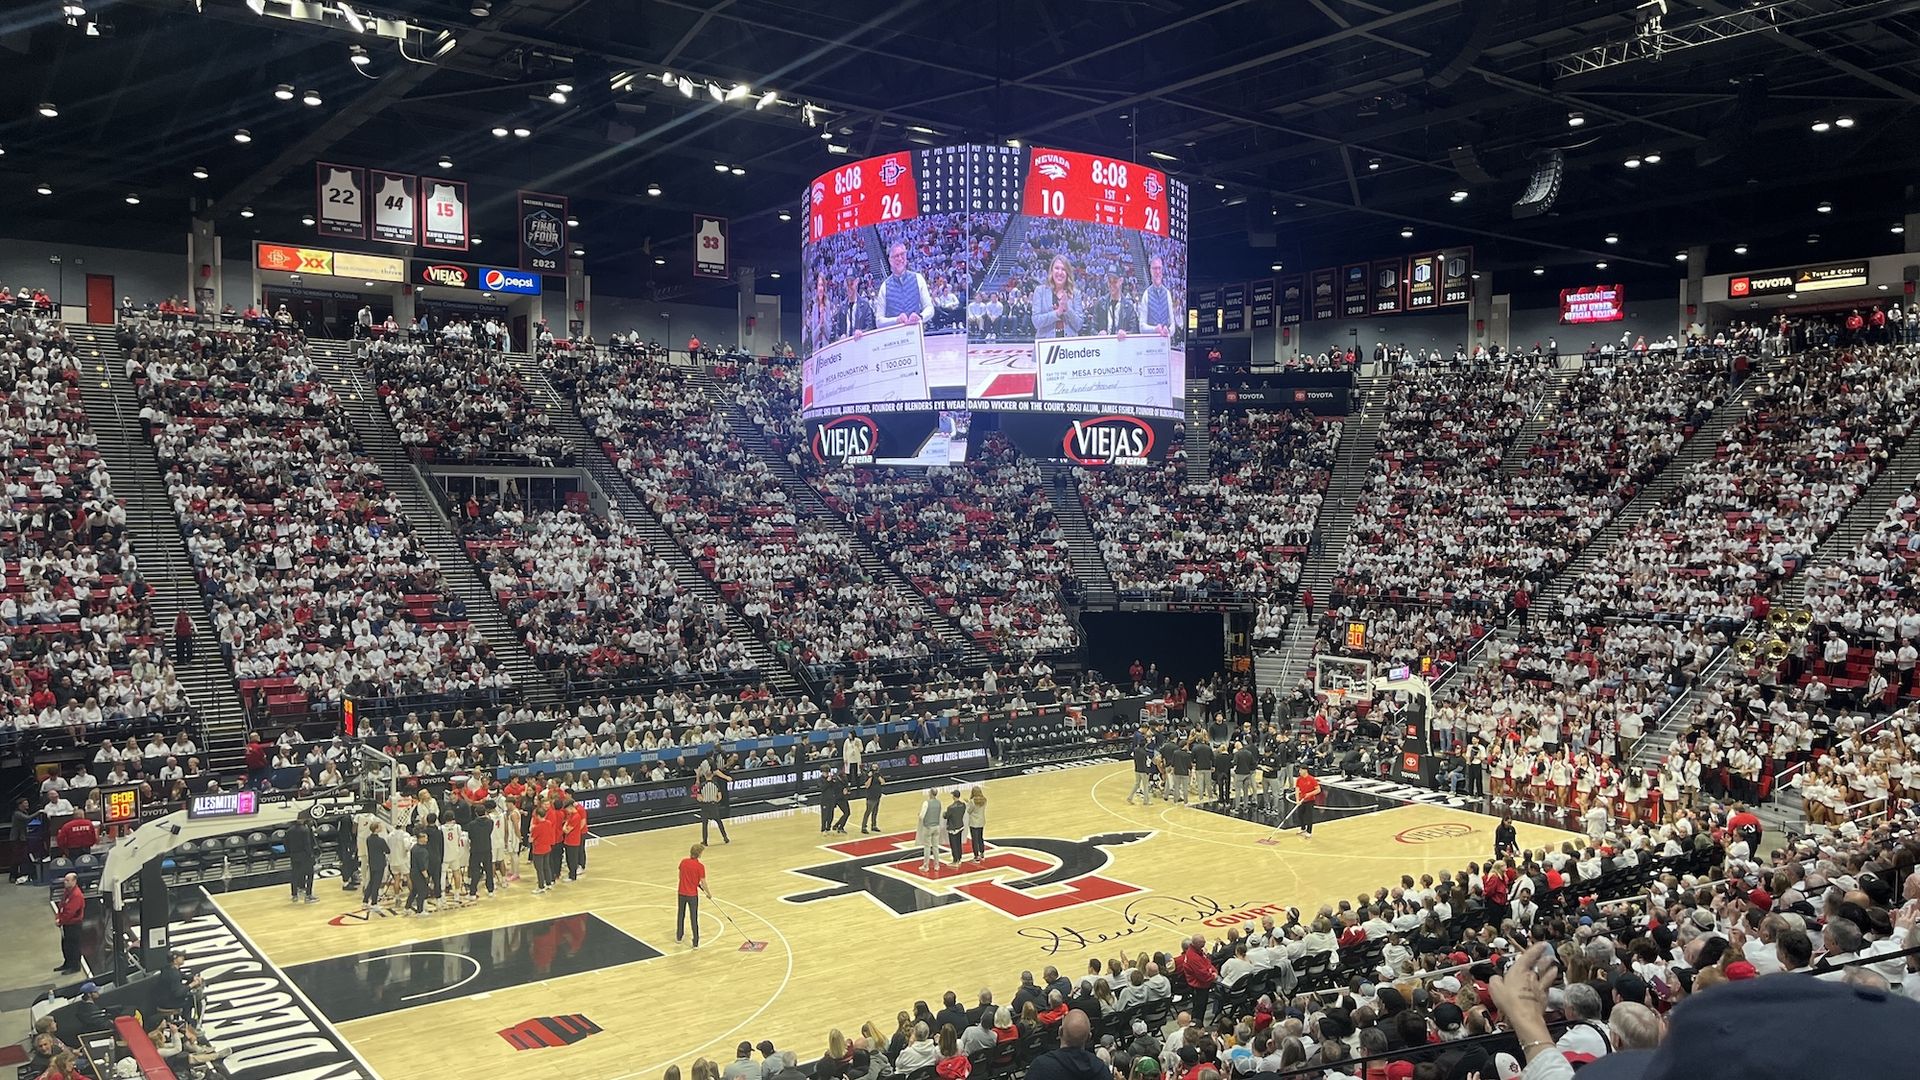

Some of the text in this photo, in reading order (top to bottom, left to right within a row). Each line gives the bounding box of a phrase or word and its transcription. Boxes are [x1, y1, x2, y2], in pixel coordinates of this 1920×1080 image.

[1034, 155, 1070, 170] NEVADA
[835, 166, 862, 195] 8:08
[1091, 160, 1128, 188] 8:08
[329, 188, 354, 205] 22
[1104, 189, 1116, 200] 1ST
[384, 196, 404, 211] 44
[881, 193, 902, 220] 26
[1041, 189, 1065, 216] 10
[436, 203, 454, 217] 15
[813, 214, 823, 238] 10
[1145, 207, 1160, 232] 26
[531, 220, 557, 233] FINAL
[533, 231, 559, 243] FOUR
[702, 236, 719, 250] 33
[532, 258, 556, 269] 2023
[427, 266, 462, 285] VIEJAS
[1837, 267, 1865, 275] Country
[505, 277, 533, 288] pepsi
[1751, 277, 1793, 290] TOYOTA
[1226, 298, 1243, 306] WAC
[1254, 293, 1272, 302] WAC
[1413, 296, 1432, 305] 2012
[1446, 292, 1465, 301] 2013
[1566, 292, 1600, 303] MISSION
[1200, 301, 1216, 310] WAC
[1378, 301, 1395, 311] 2012
[1571, 302, 1613, 313] PLAY UNDER
[1565, 308, 1618, 320] OFFICIAL REVIEW
[1059, 347, 1101, 360] Blenders
[820, 353, 842, 369] Blenders
[837, 364, 868, 378] FOUNDATION
[876, 363, 880, 372] $
[1072, 369, 1091, 377] MESA
[1093, 366, 1133, 376] FOUNDATION
[872, 403, 895, 412] FOUNDER
[896, 401, 904, 411] OF
[905, 401, 933, 411] BLENDERS
[934, 401, 947, 410] EYE
[948, 401, 966, 409] WEAR
[968, 402, 990, 410] DAVID
[991, 402, 1017, 410] WICKER
[1018, 402, 1029, 411] ON
[1031, 403, 1042, 411] THE
[1044, 403, 1065, 412] COURT,
[1082, 404, 1100, 413] ALUM,
[818, 424, 869, 464] VIEJAS
[1072, 420, 1144, 464] VIEJAS
[848, 455, 873, 464] arena
[1115, 457, 1148, 465] arena
[1348, 632, 1361, 646] 30
[922, 748, 986, 764] SUPPORT AZTEC BASKETBALL
[420, 777, 445, 785] TOYOTA
[734, 779, 751, 790] AZTEC
[752, 775, 786, 787] BASKETBALL
[1401, 772, 1420, 780] TOYOTA
[111, 791, 134, 804] 8:08
[193, 795, 238, 812] ALESMITH
[111, 804, 130, 818] 30
[141, 808, 169, 817] OYOTA
[495, 820, 500, 829] 4
[447, 832, 453, 841] 8
[1404, 825, 1468, 841] VIEJAS
[1203, 904, 1285, 928] COURT
